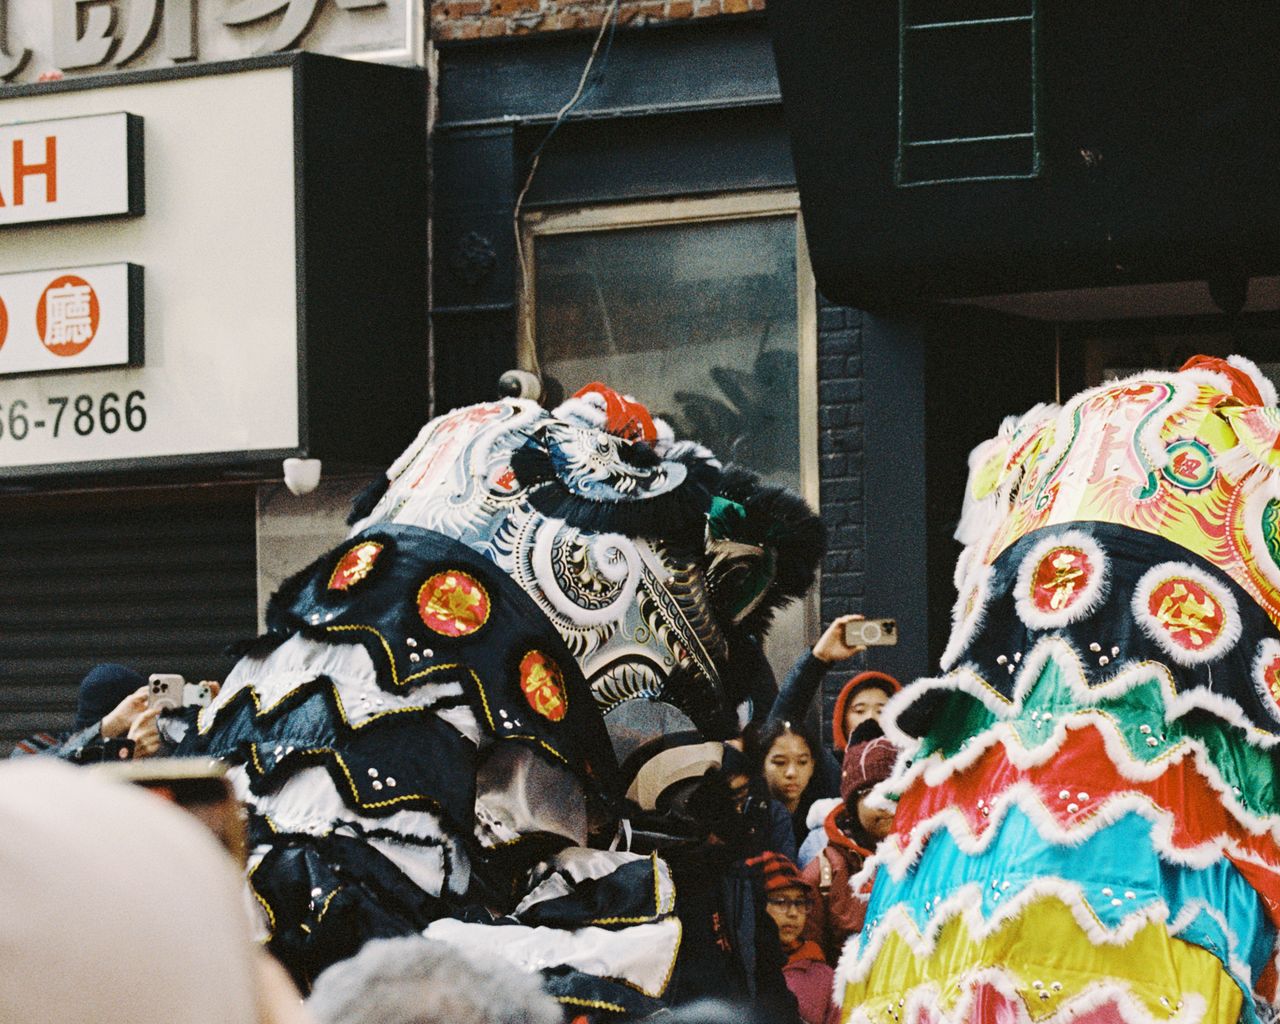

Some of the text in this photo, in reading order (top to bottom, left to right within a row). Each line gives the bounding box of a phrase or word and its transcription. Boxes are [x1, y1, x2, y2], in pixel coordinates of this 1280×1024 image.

[0, 136, 57, 208] H
[43, 283, 93, 346] 廳
[0, 390, 147, 441] 6-7866
